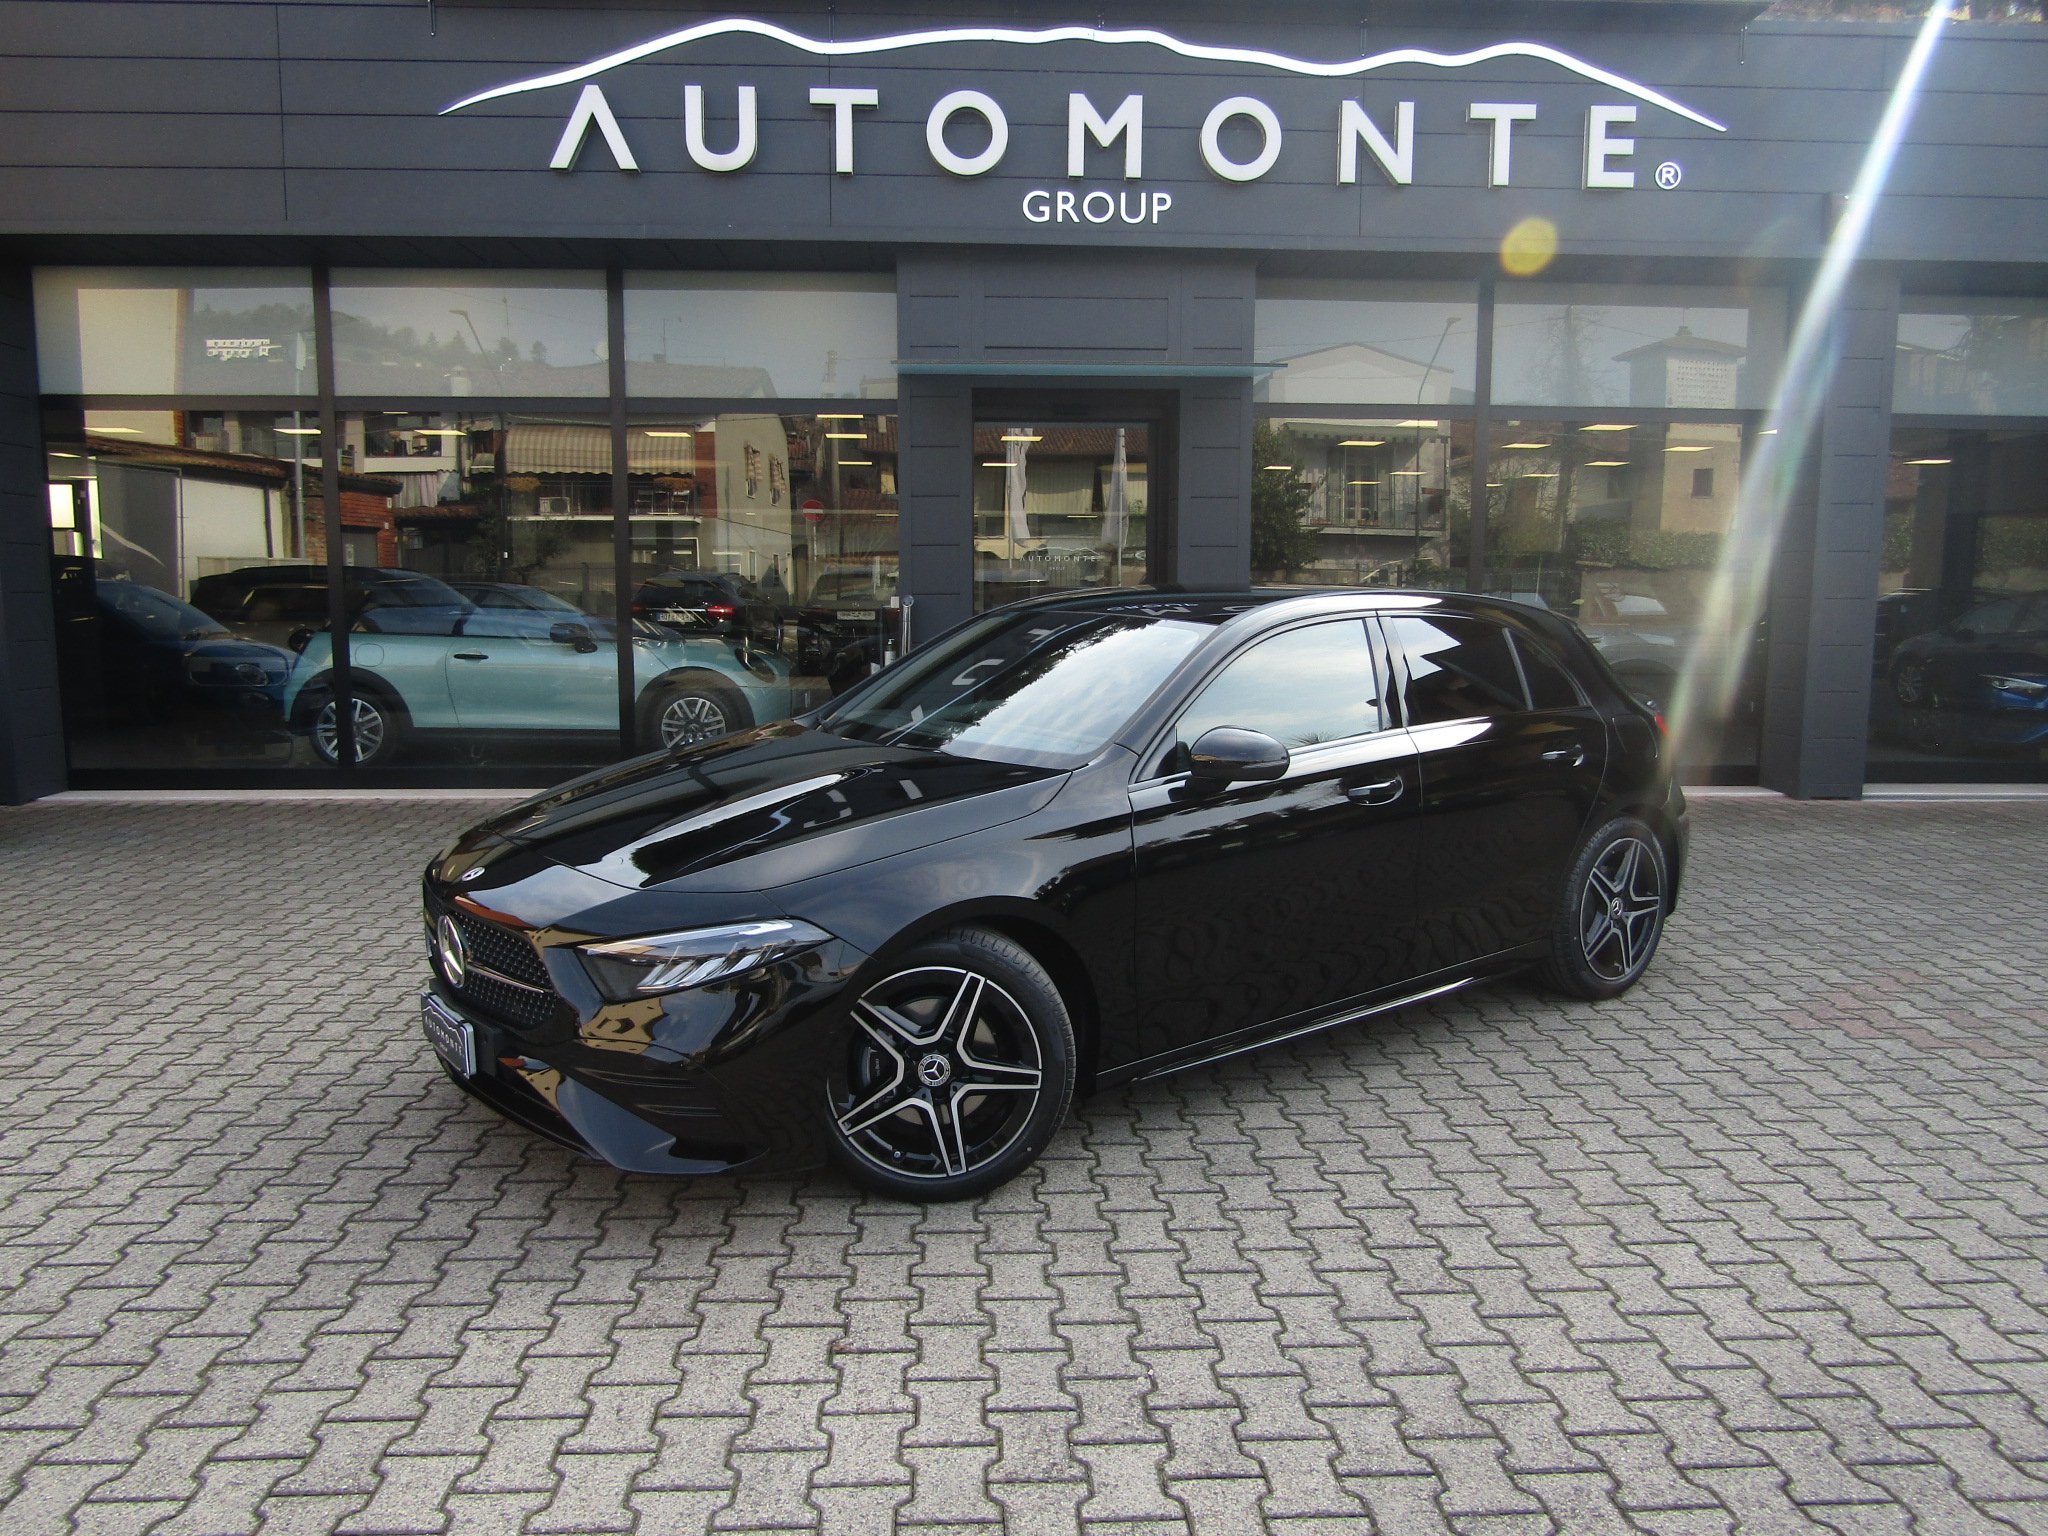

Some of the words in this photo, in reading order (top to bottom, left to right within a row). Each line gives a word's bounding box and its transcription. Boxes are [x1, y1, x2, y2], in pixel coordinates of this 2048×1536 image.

[549, 83, 1638, 189] AUTOMONTE
[1022, 190, 1172, 224] GROUP
[424, 1015, 463, 1056] AUTOMONTE
